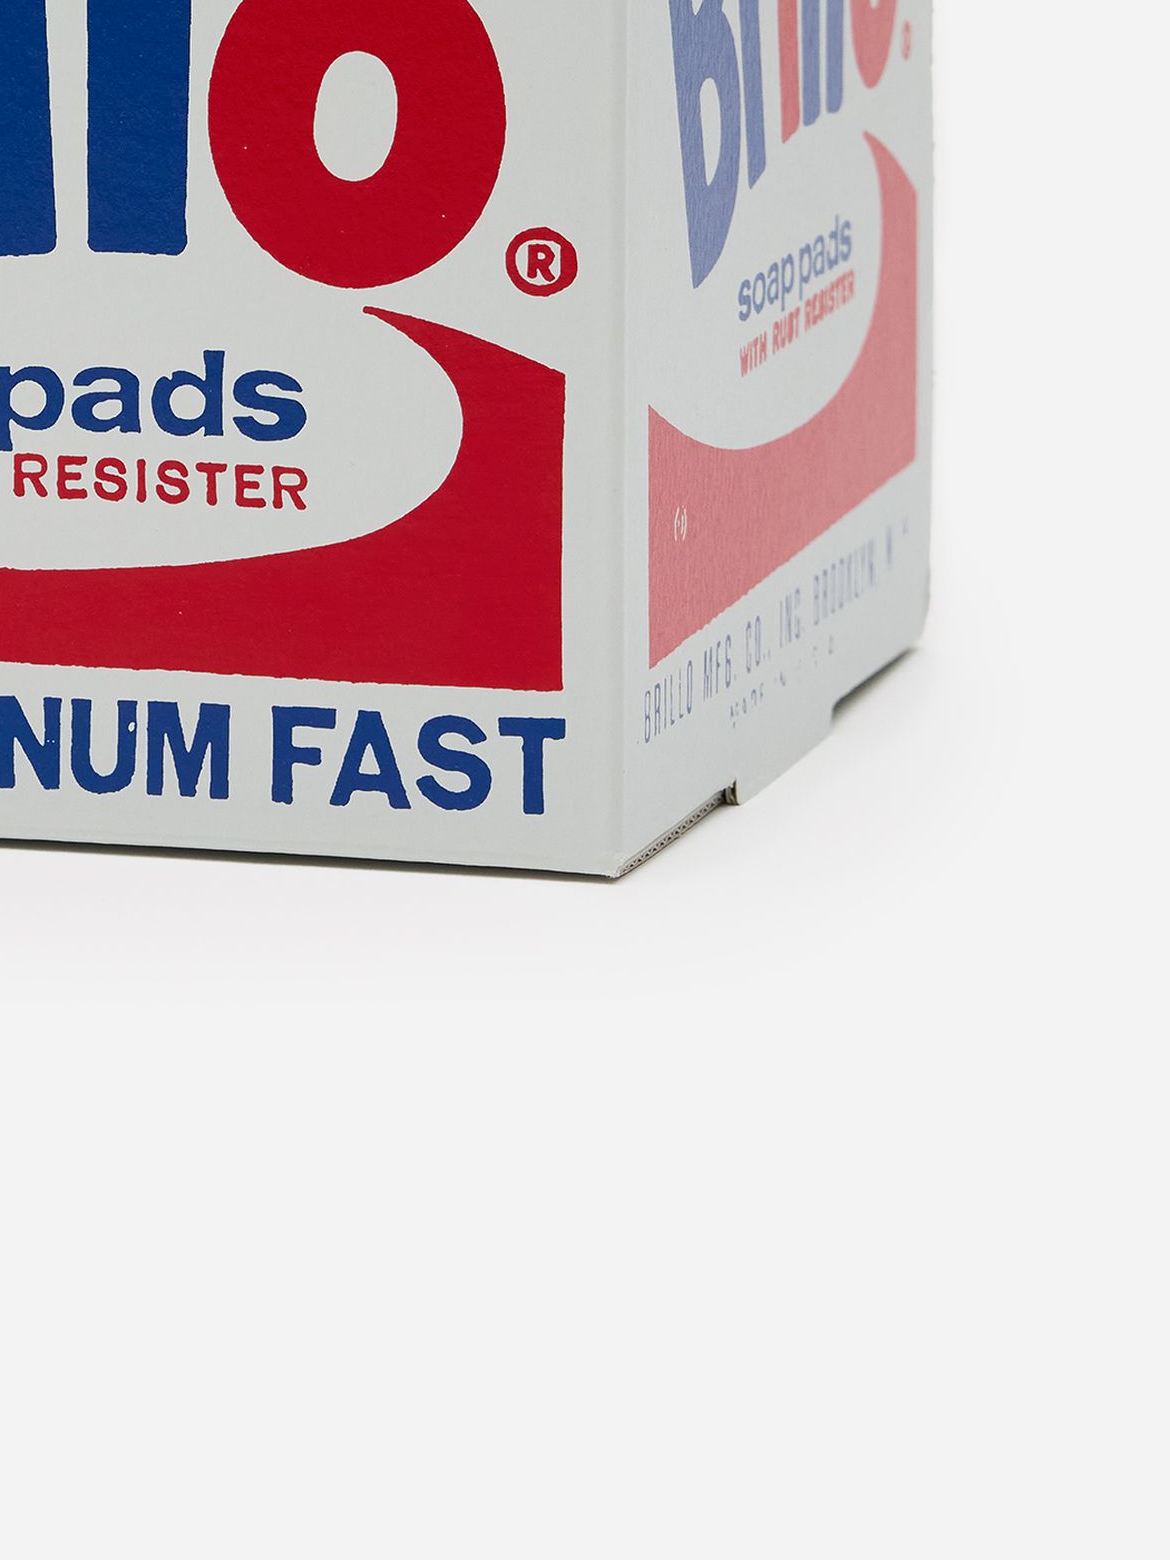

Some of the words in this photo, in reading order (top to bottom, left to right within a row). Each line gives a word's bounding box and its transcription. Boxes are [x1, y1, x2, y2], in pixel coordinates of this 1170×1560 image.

[737, 253, 795, 322] soap
[799, 214, 852, 301] pads
[739, 330, 768, 377] WITH
[13, 452, 309, 512] RESISTER
[643, 659, 694, 744] BRILLO
[270, 704, 567, 815] FAST
